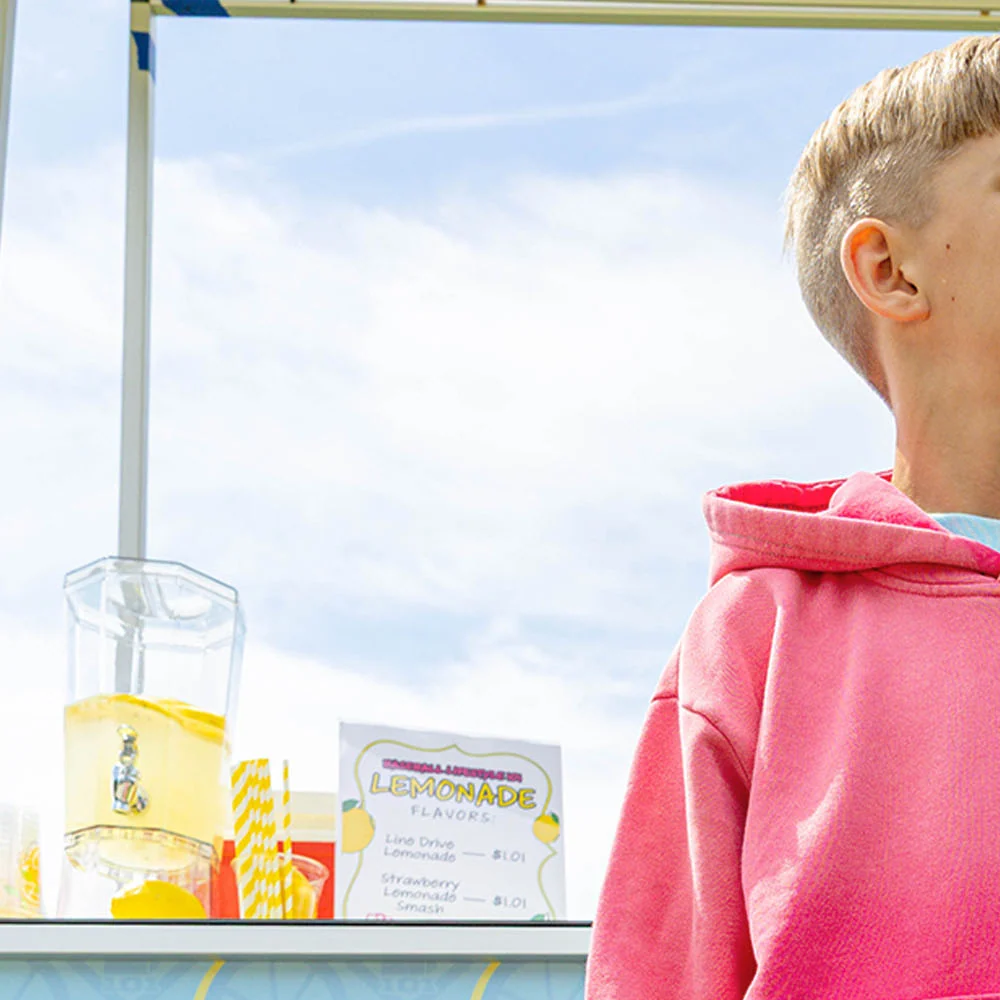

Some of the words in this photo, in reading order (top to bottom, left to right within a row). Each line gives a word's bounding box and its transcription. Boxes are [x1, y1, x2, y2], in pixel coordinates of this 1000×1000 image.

[369, 772, 537, 810] LEMONADE
[385, 833, 415, 847] Line
[419, 836, 455, 850] Drive
[383, 846, 456, 863] Lemonade
[492, 849, 526, 863] $1.01
[381, 872, 460, 891] Strawberry
[383, 887, 457, 903] Lemonade
[493, 895, 527, 909] $1.01
[396, 900, 445, 914] Smash
